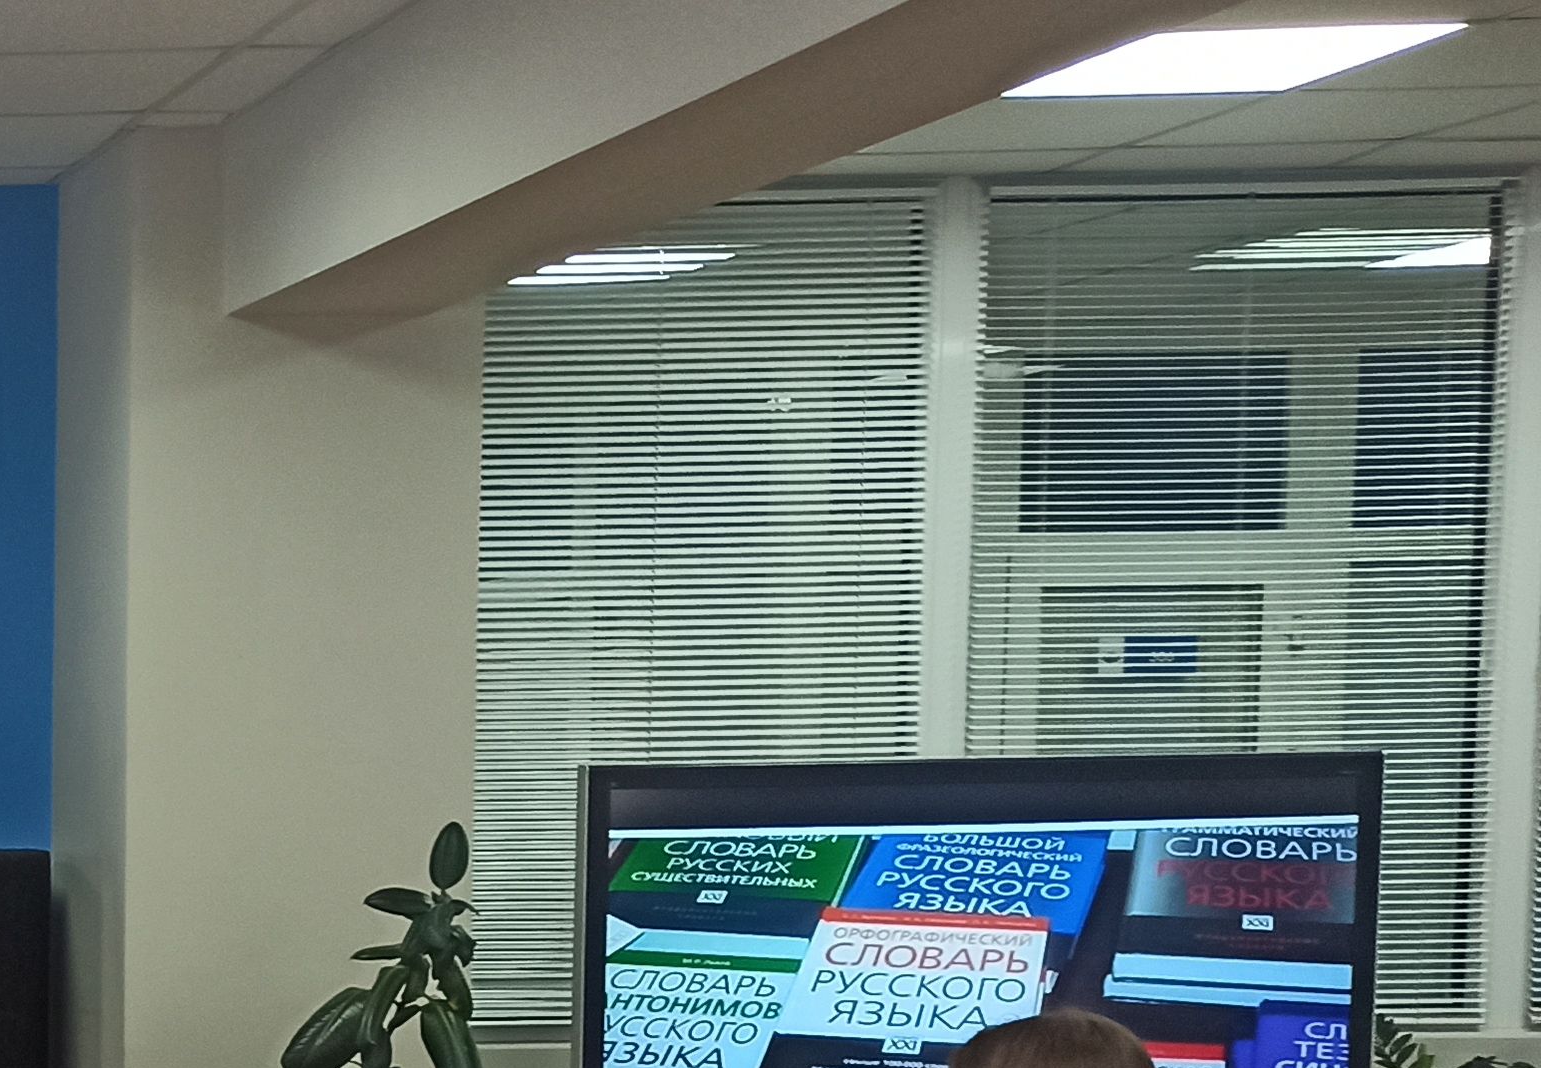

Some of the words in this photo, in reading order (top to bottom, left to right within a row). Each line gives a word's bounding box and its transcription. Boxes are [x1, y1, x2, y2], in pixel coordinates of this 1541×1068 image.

[664, 840, 816, 860] СЛОВАРЬ
[1166, 837, 1358, 862] СЛОВАРЬ
[667, 858, 792, 874] РУССКИХ
[894, 854, 1071, 880] СЛОВАРЬ
[631, 871, 817, 888] СУЩЕСТВИТЕЛЬНЫХ
[876, 871, 1070, 900] РУССКОГО
[894, 892, 1031, 917] ЯЗЫКА
[1187, 885, 1332, 909] ЯЗЫКА
[833, 927, 1032, 947] ОРФОГРАФИЧЕСКИЙ
[826, 942, 1029, 974] СЛОВАРЬ
[610, 968, 776, 997] СЛОВАРЬ
[811, 969, 1025, 1003] РУССКОГО
[606, 992, 782, 1019] НТОНИМОВ
[828, 999, 988, 1030] ЯЗЫКА
[604, 1014, 758, 1045] УССКОГО
